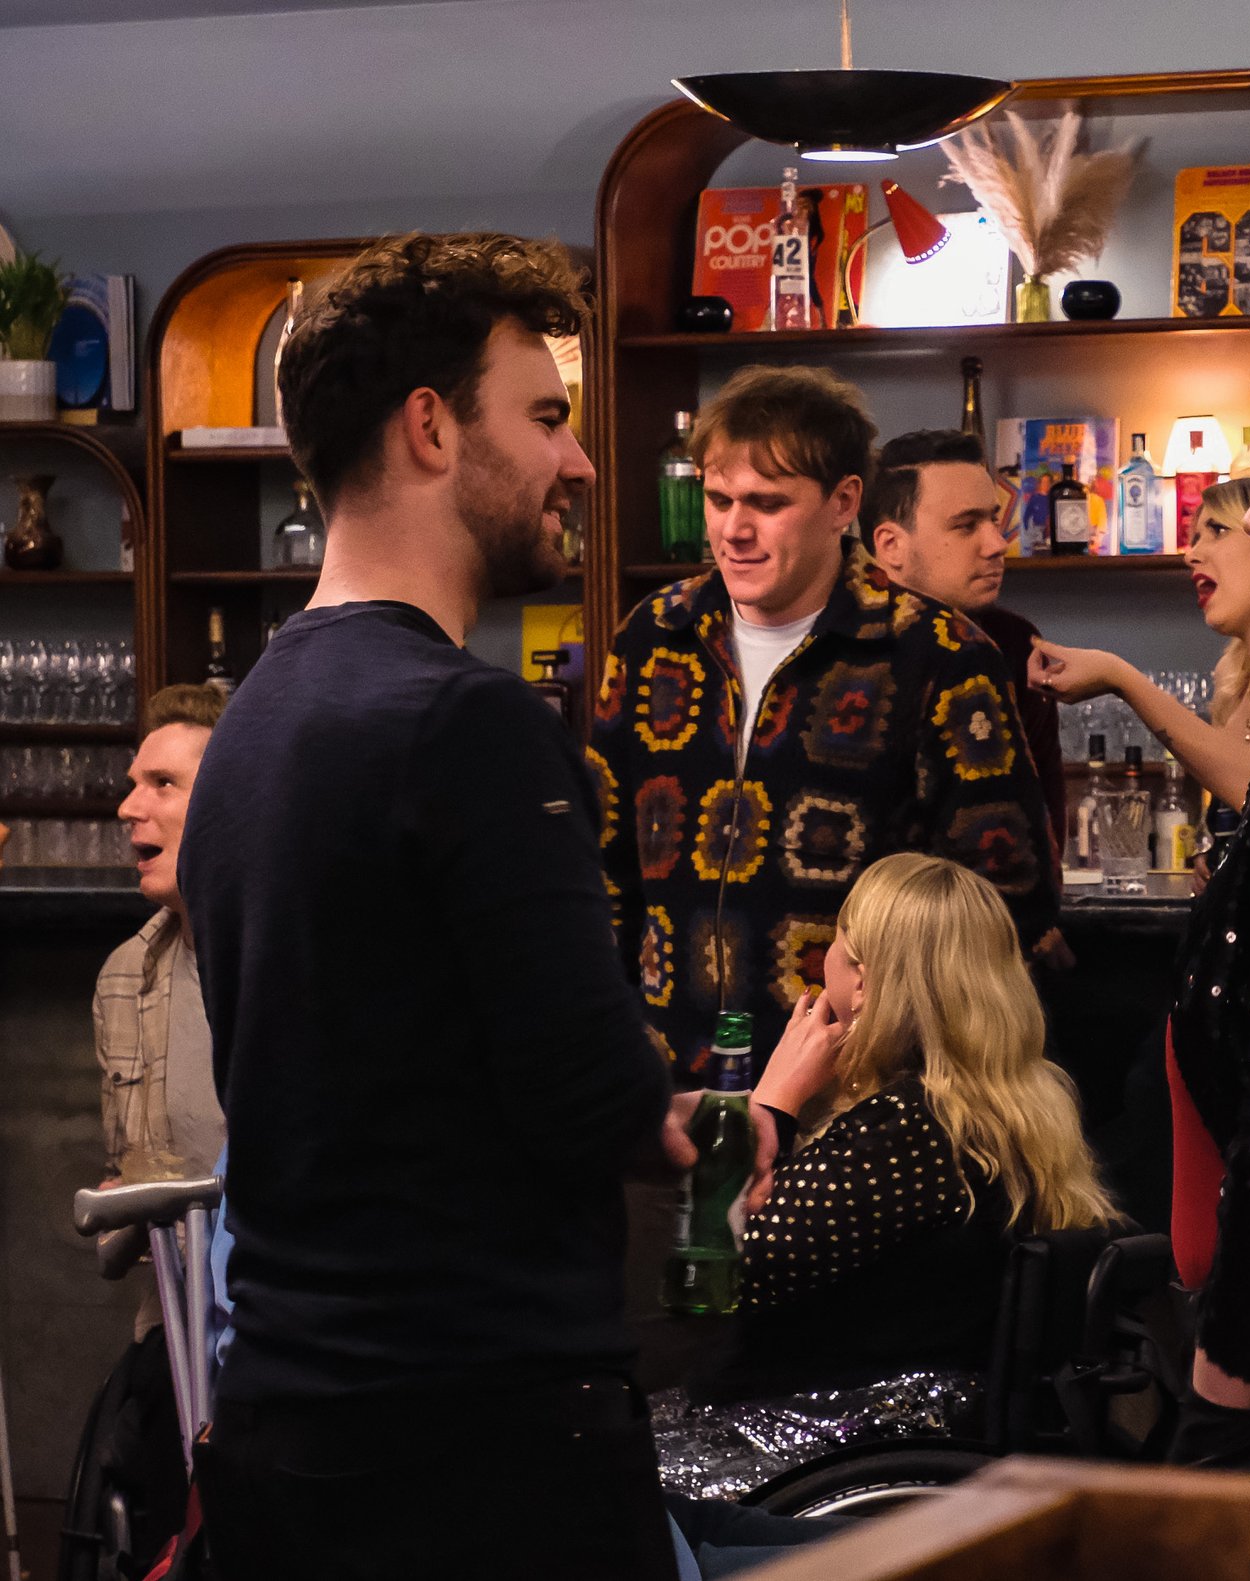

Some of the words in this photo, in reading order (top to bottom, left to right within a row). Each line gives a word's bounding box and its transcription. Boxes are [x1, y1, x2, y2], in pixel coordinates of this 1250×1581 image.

[703, 224, 775, 256] POP
[773, 237, 802, 268] 42
[709, 254, 767, 270] COUNTRY
